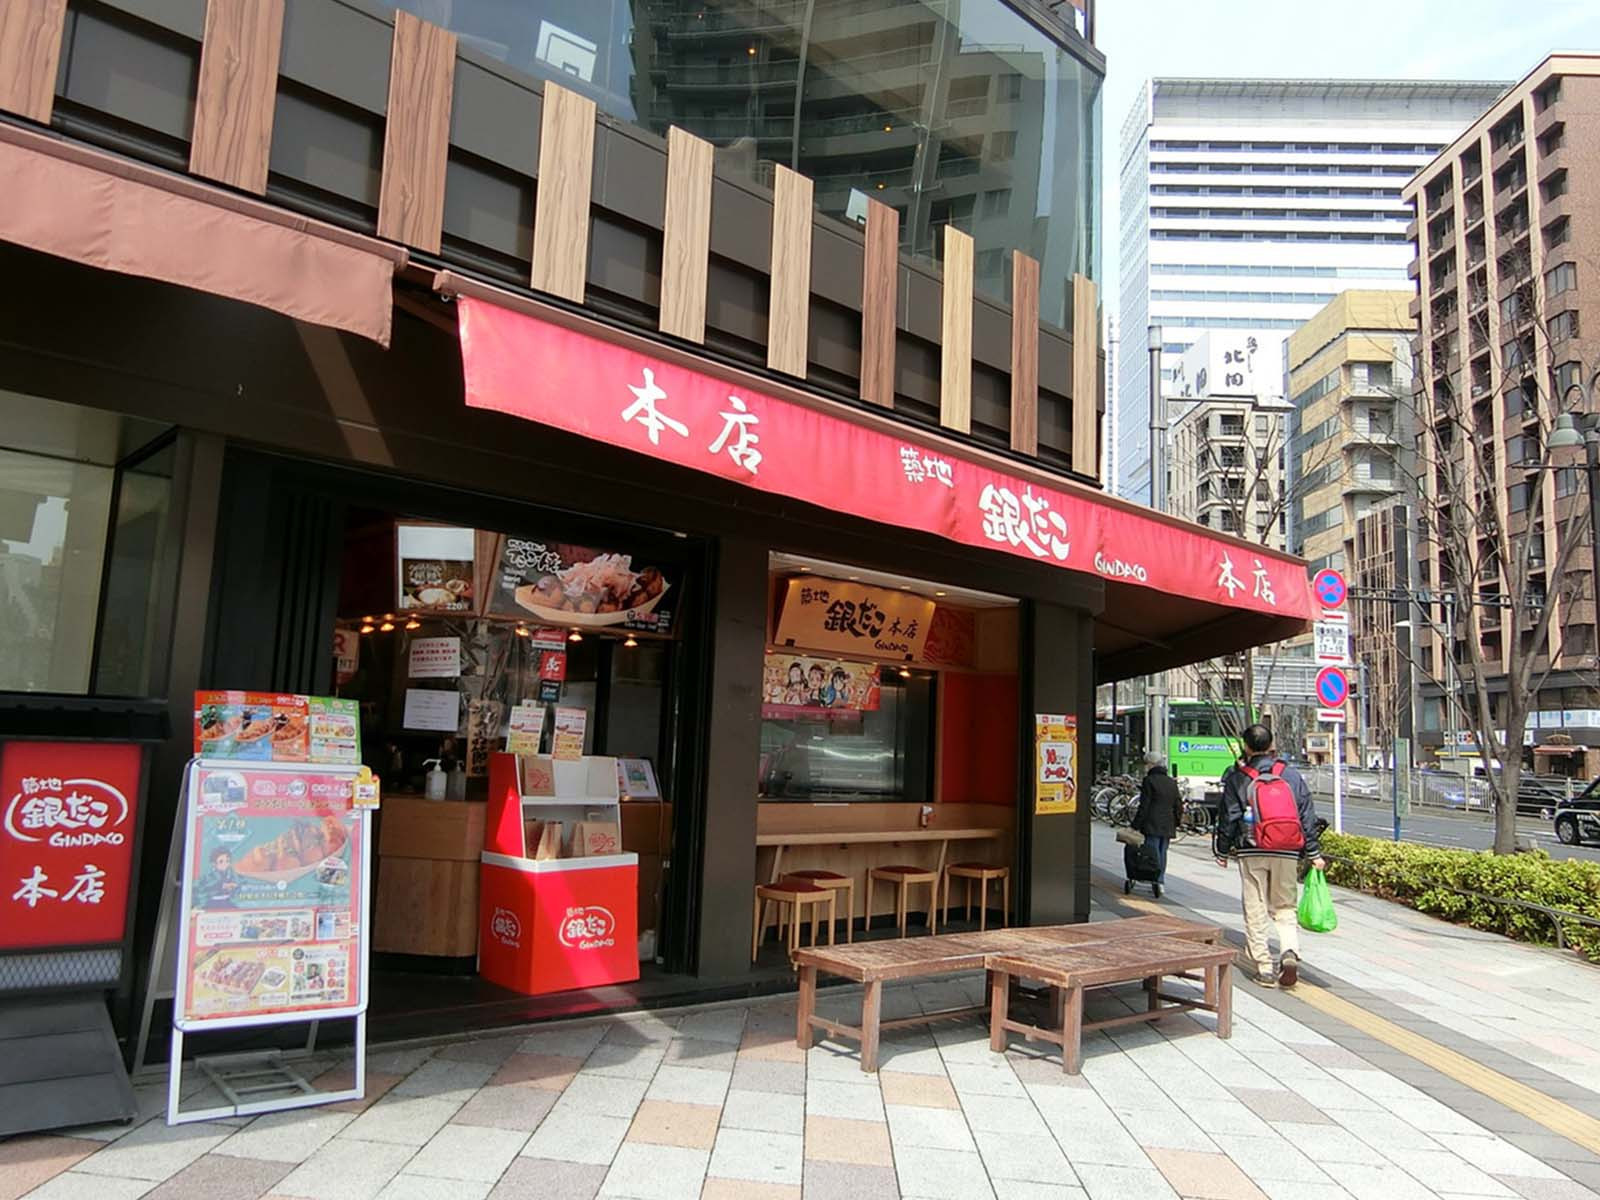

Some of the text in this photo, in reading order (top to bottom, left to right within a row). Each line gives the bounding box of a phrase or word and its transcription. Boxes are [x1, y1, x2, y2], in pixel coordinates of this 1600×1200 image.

[621, 367, 764, 474] 本店
[899, 446, 954, 488] 築地
[978, 484, 1070, 561] 銀だこ
[1094, 552, 1148, 582] GINDACO
[1217, 550, 1277, 606] 本店
[824, 598, 885, 638] 銀だこ
[888, 617, 919, 639] 本店
[20, 791, 109, 828] 銀だこ
[49, 832, 124, 847] GINDACO
[13, 864, 106, 907] 本店
